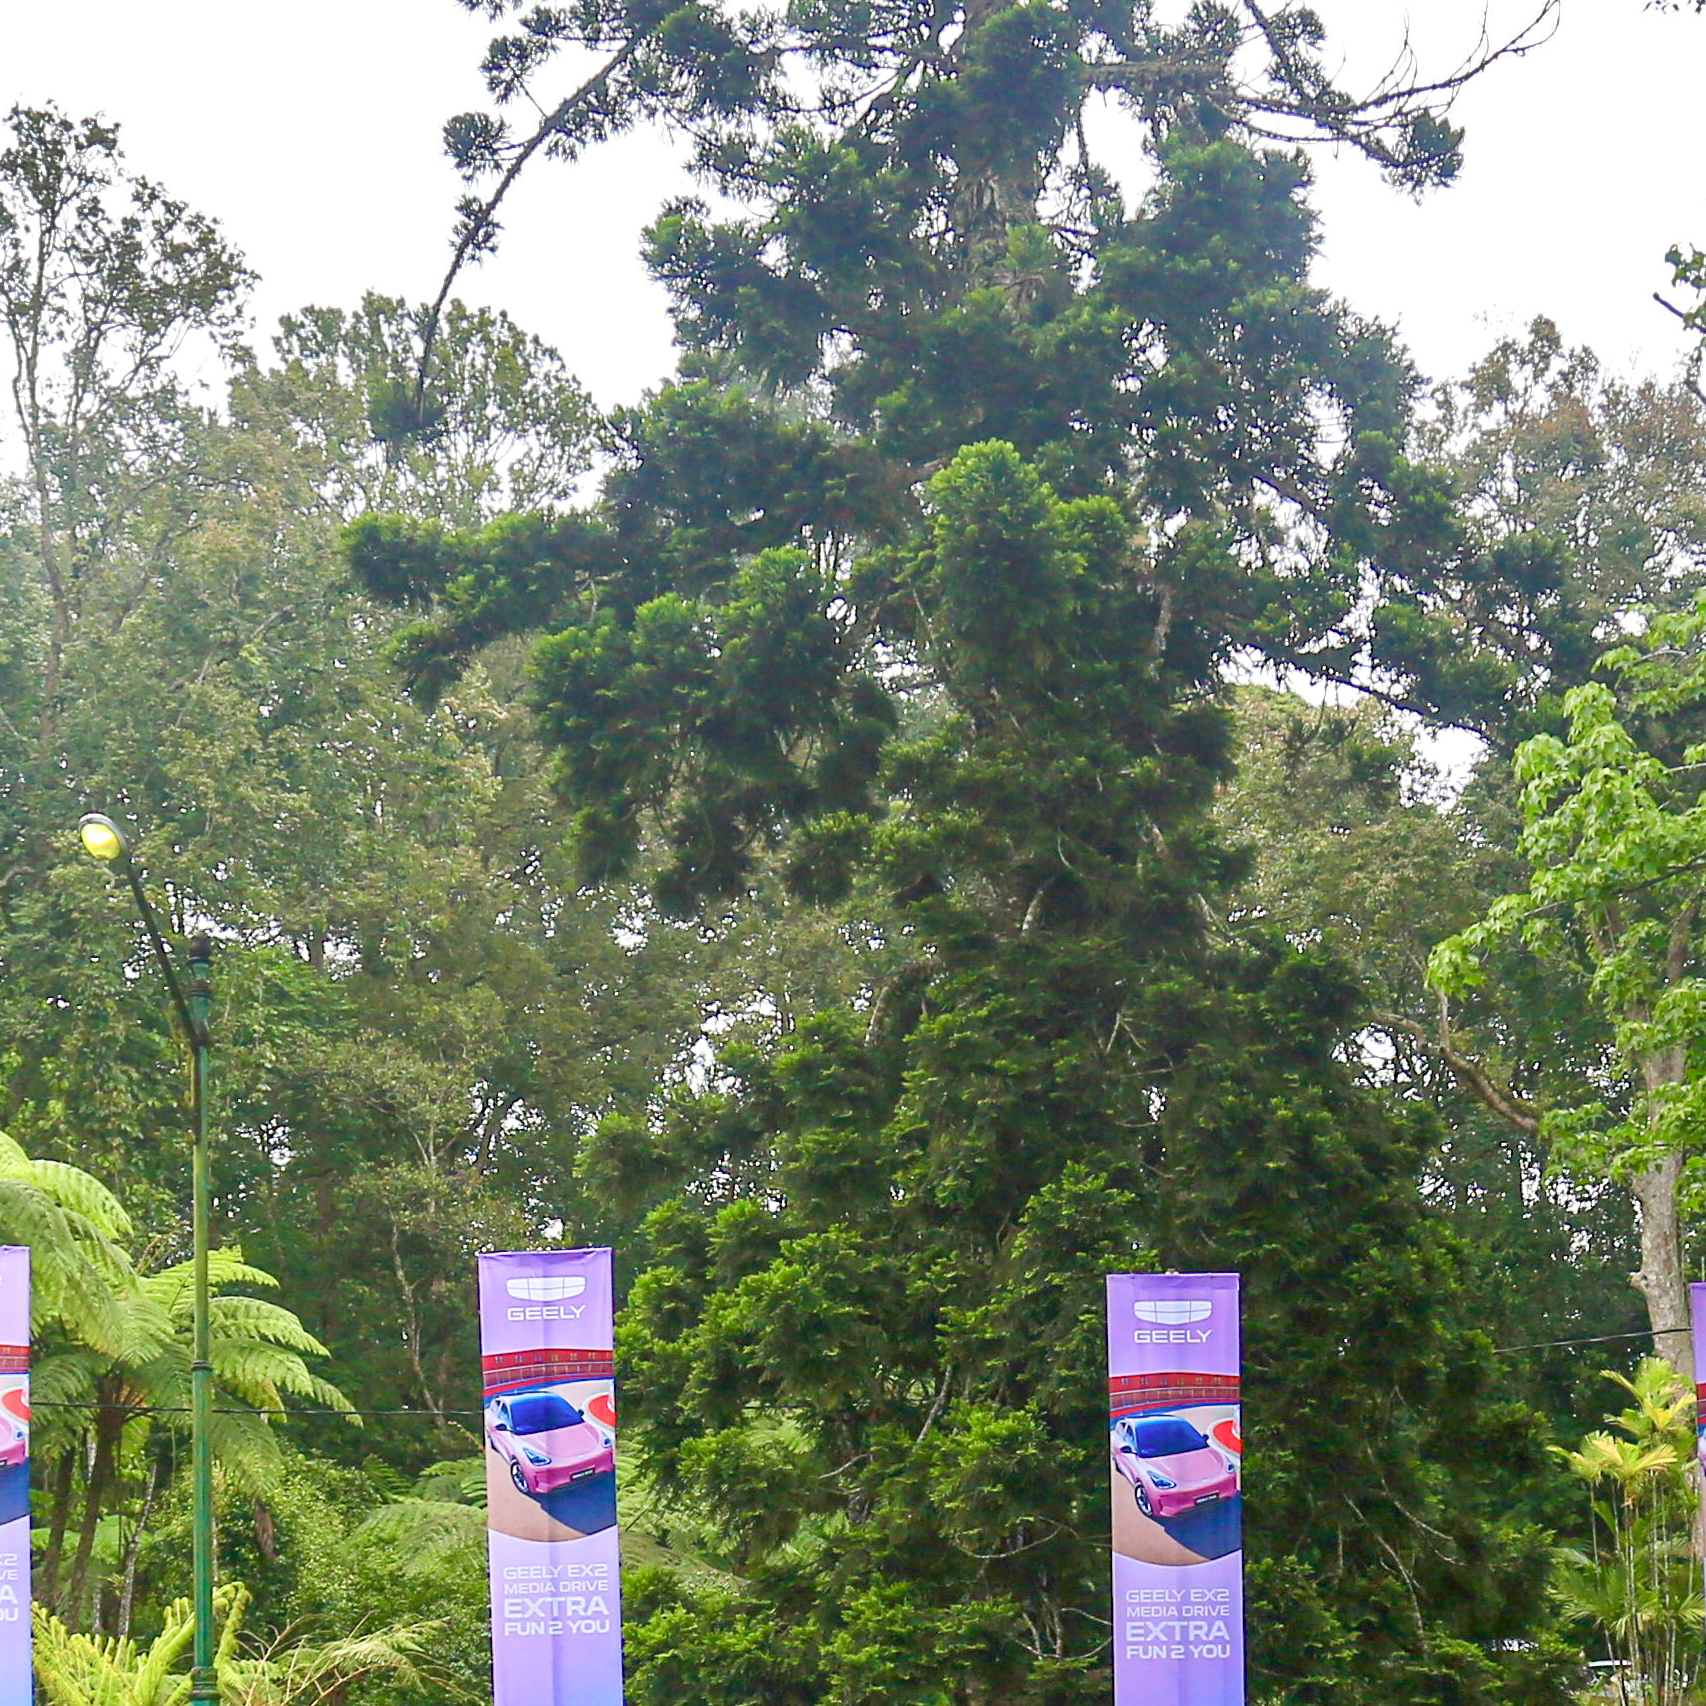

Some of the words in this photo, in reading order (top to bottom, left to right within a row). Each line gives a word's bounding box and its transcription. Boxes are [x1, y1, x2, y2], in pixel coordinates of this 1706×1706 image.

[507, 1305, 586, 1321] GEELY
[1134, 1329, 1213, 1344] GEELY
[503, 1565, 563, 1580] GEELY
[567, 1563, 609, 1578] EX2
[504, 1582, 556, 1594] MEDIA
[559, 1580, 609, 1592] DRIVE
[1126, 1589, 1186, 1603] GEELY
[1190, 1588, 1230, 1602] EX2
[504, 1595, 610, 1618] EXTRA
[1126, 1606, 1178, 1617] MEDIA
[1182, 1605, 1230, 1617] DRIVE
[504, 1621, 545, 1636] FUN
[549, 1621, 563, 1635] 2
[567, 1619, 610, 1634] YOU
[1126, 1620, 1230, 1642] EXTRA
[1126, 1645, 1167, 1660] FUN
[1171, 1645, 1185, 1659] 2
[1189, 1644, 1230, 1659] YOU
